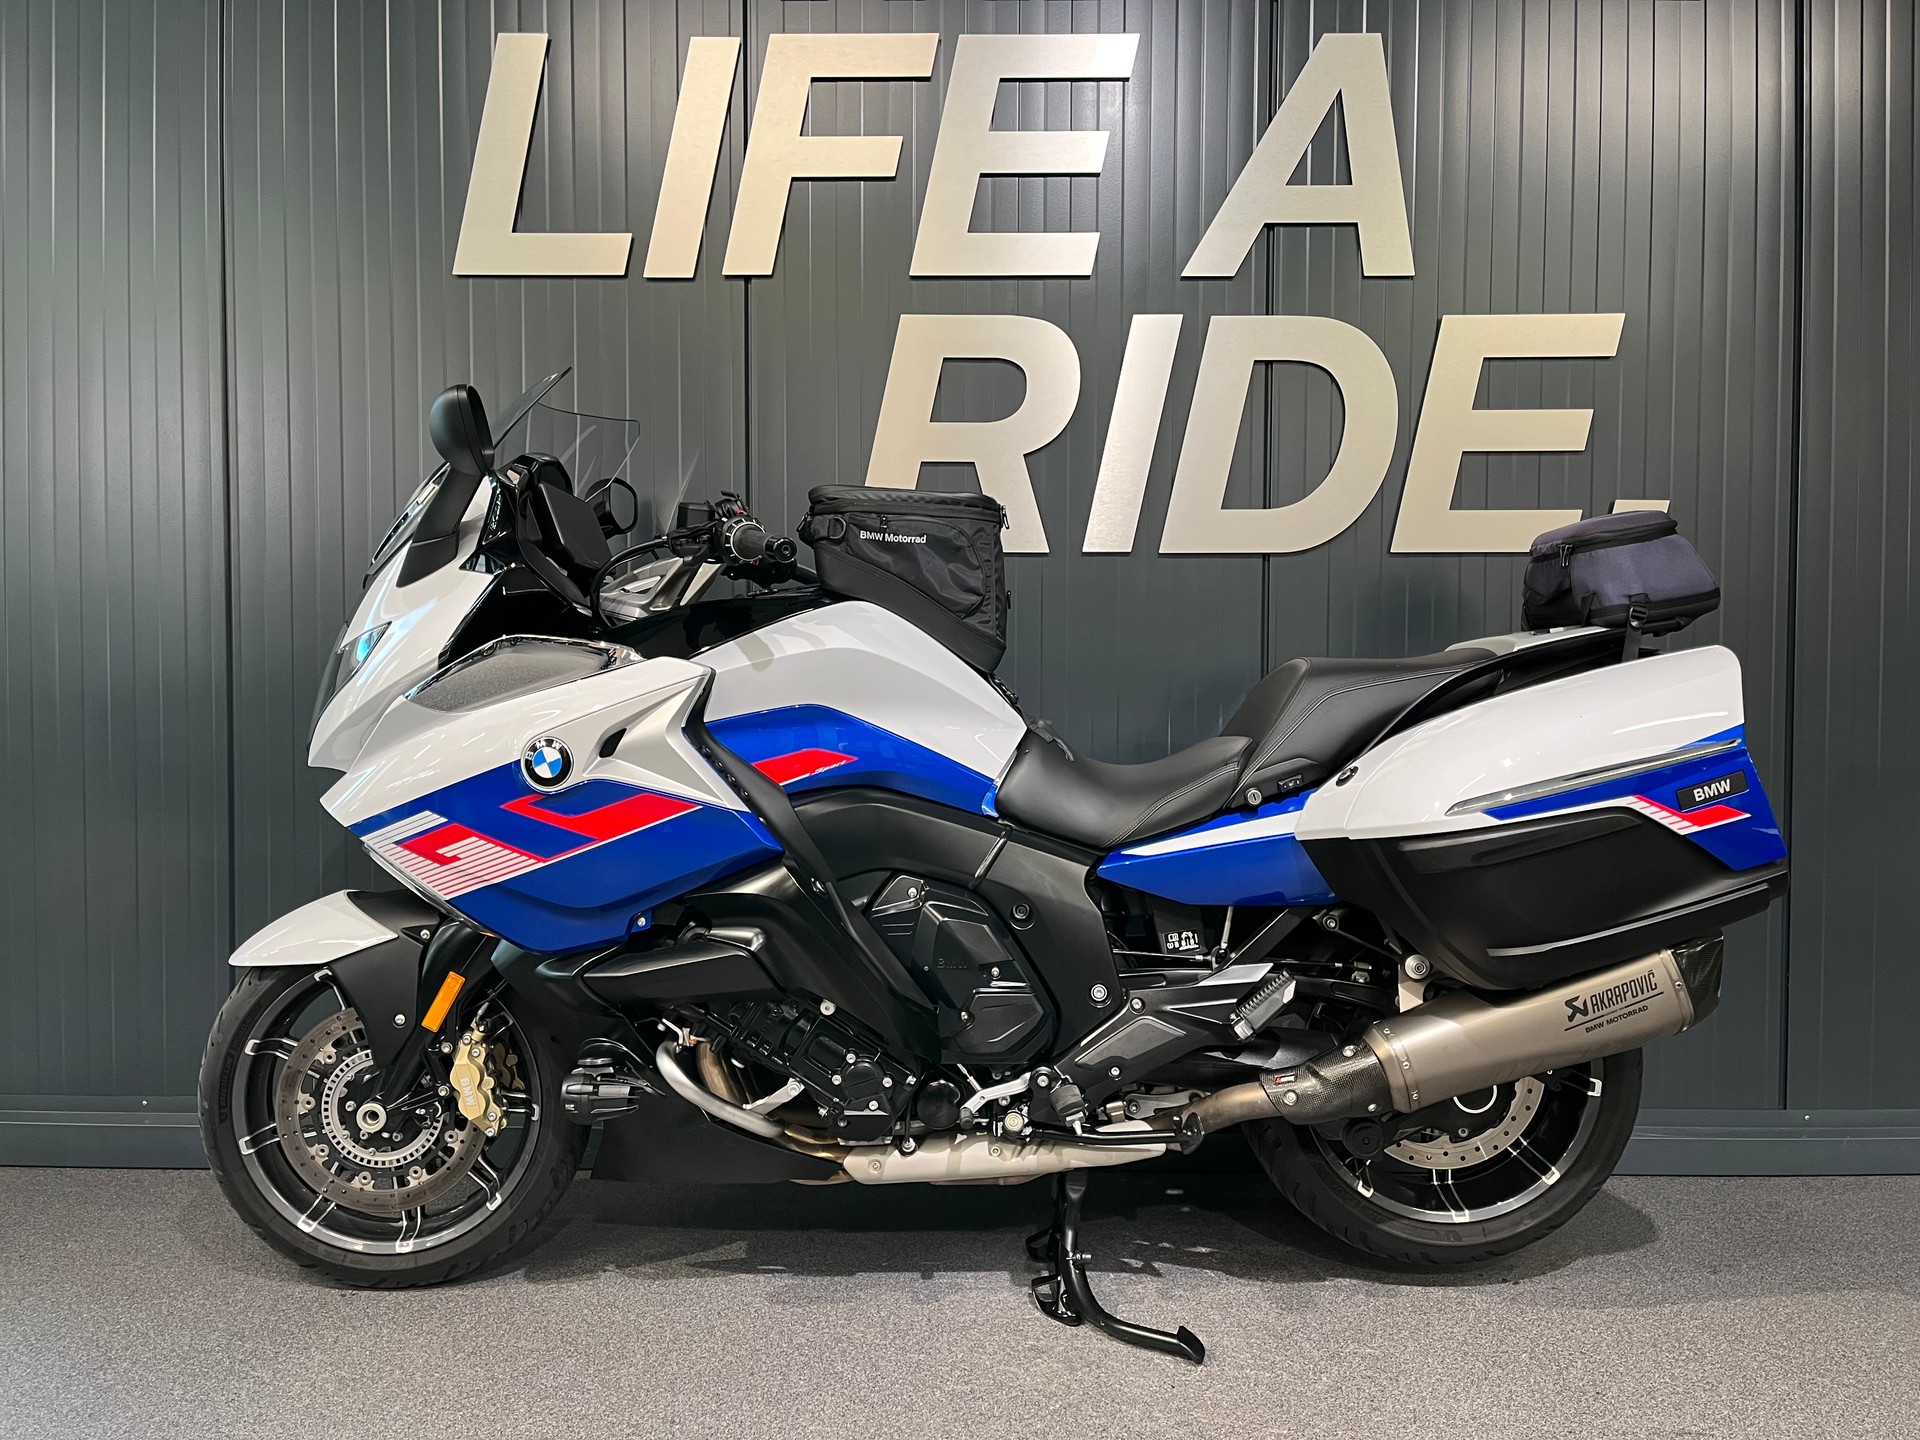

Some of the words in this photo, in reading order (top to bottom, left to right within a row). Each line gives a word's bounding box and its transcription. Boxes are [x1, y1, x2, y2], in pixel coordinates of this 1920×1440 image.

[452, 33, 1140, 278] LIFE
[1180, 32, 1416, 277] A
[865, 313, 1670, 553] RIDE
[860, 530, 883, 541] BMW
[884, 533, 927, 544] Motorrad
[525, 739, 563, 760] BMW
[1693, 779, 1730, 802] BMW
[1585, 1021, 1604, 1034] BMW
[1606, 1005, 1649, 1026] MOTORRAD
[461, 1077, 477, 1107] BMW
